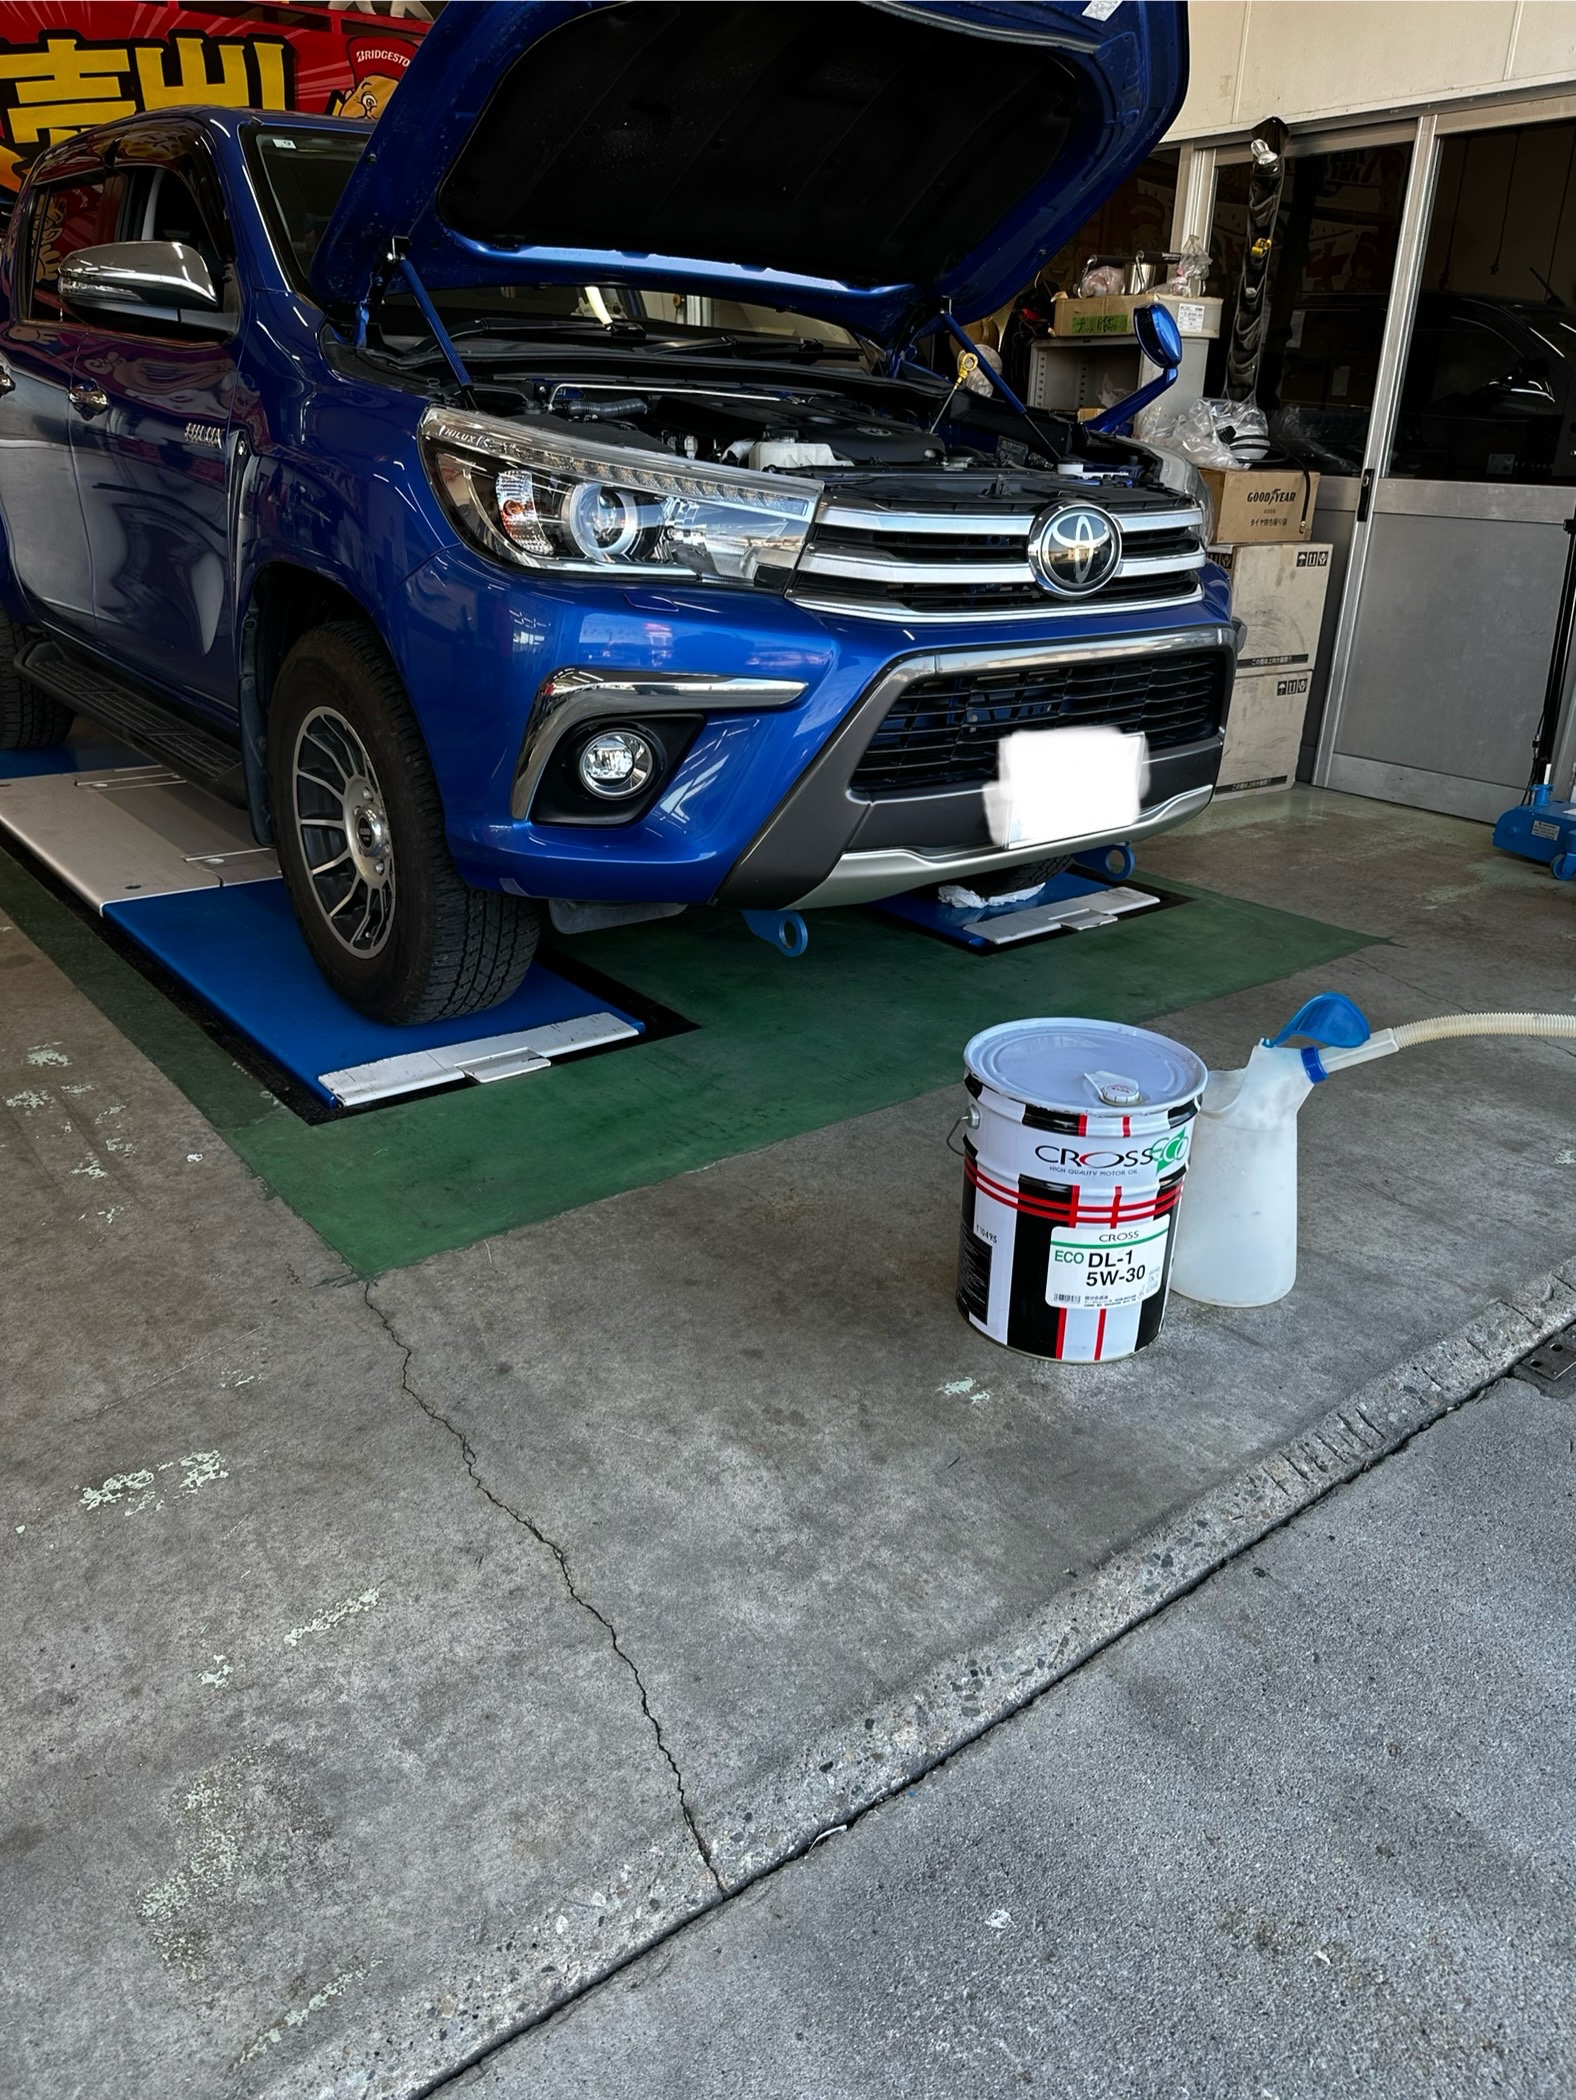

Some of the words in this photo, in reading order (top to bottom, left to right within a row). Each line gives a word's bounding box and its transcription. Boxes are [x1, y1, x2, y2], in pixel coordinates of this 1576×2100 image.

[356, 49, 411, 67] BRIDGESTO
[445, 428, 476, 443] HILUX
[1247, 488, 1296, 506] GOODYEAR
[1034, 1144, 1154, 1169] CROSS
[1150, 1136, 1189, 1163] ECO
[1068, 1168, 1098, 1176] QUALITY
[1099, 1230, 1140, 1242] CROSS
[1054, 1249, 1085, 1264] ECO
[1088, 1249, 1133, 1268] DL-1
[1086, 1264, 1146, 1287] 5W-30
